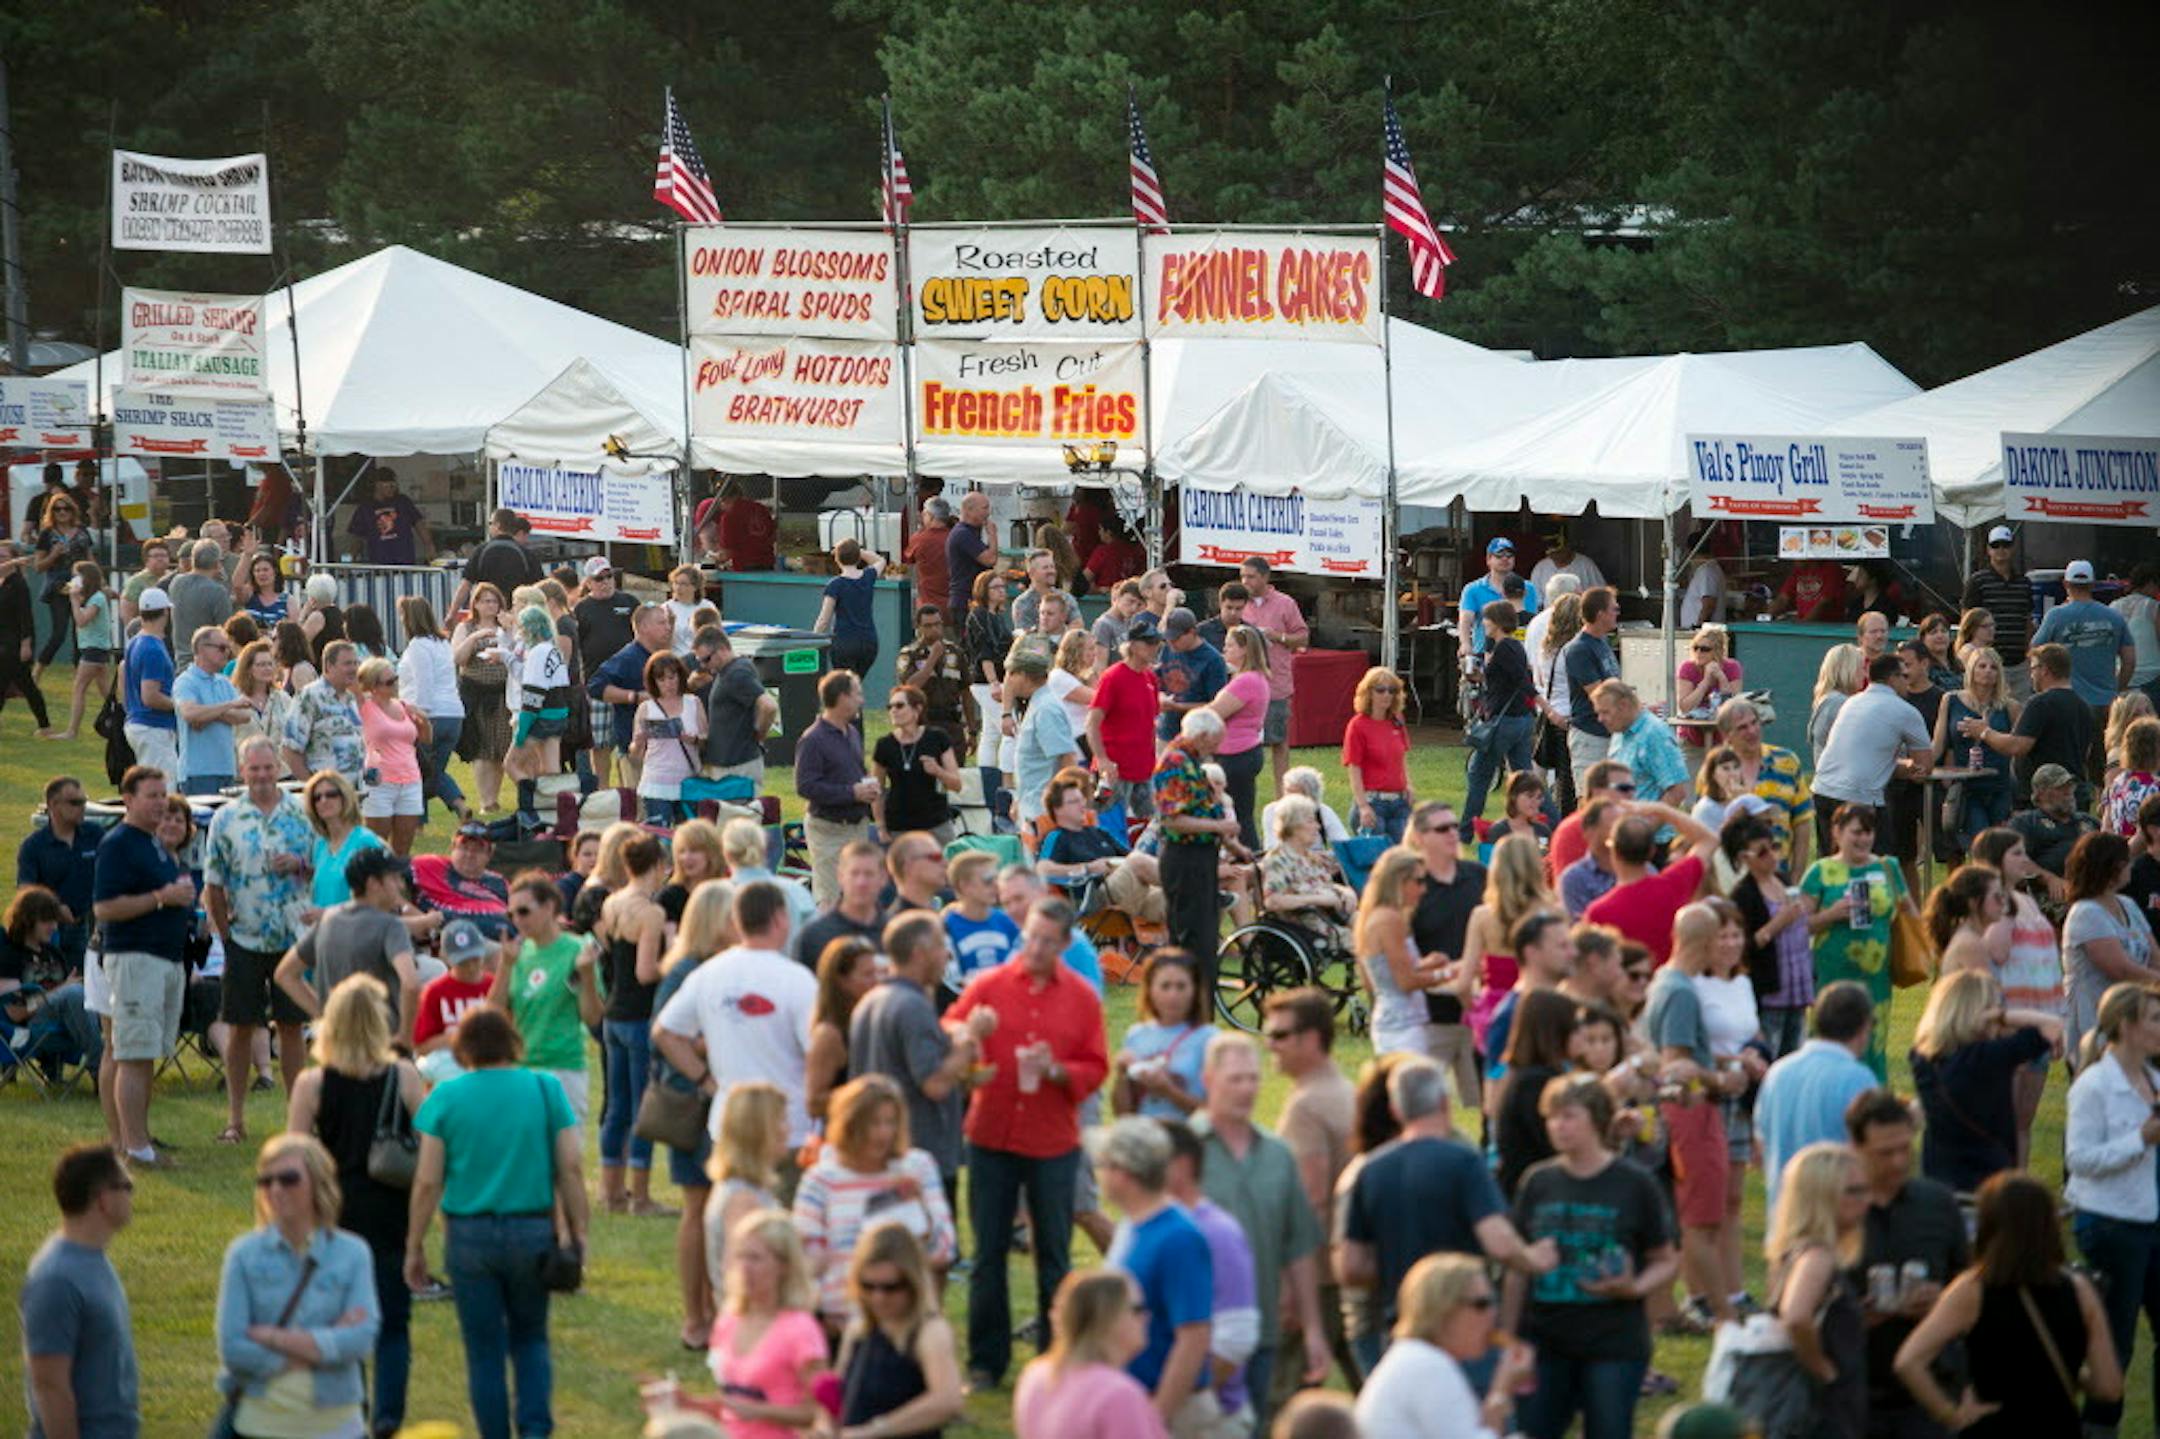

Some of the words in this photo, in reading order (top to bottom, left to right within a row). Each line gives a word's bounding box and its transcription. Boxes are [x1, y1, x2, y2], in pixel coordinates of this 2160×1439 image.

[129, 192, 190, 214] SHRIMP
[194, 194, 257, 214] COCKTAIL
[692, 247, 765, 277] ONION
[771, 248, 889, 282] BLOSSOMS
[955, 245, 1098, 271] Roasted
[921, 276, 1030, 325] SWEET
[1042, 274, 1135, 325] CORN
[1158, 247, 1275, 326] FUNNEL
[1277, 247, 1371, 326] CAKES
[132, 302, 195, 328] GRILLED
[202, 307, 258, 337] SHRIMP
[714, 289, 791, 320] SPIRAL
[799, 290, 872, 322] SPUDS
[132, 350, 192, 371] ITALIAN
[195, 355, 260, 376] SAUSAGE
[793, 354, 892, 387] HOTDOGS
[959, 348, 1038, 379] Fresh
[1056, 351, 1104, 381] Cut
[115, 409, 168, 426] SHRIMP
[170, 411, 215, 428] SHACK
[728, 394, 865, 427] BRATWURST
[923, 381, 1043, 437] French
[1053, 384, 1136, 440] Fries
[1693, 440, 1733, 482] Val's
[1736, 441, 1784, 496] Pinoy
[1788, 442, 1830, 486] Grill
[2006, 446, 2072, 488] DAKOTA
[2076, 449, 2159, 493] JUNCTION
[501, 463, 553, 512] CAROLINA
[554, 468, 604, 516] CATERING
[1184, 488, 1246, 531] CAROLINA
[1249, 494, 1305, 536] CATERING
